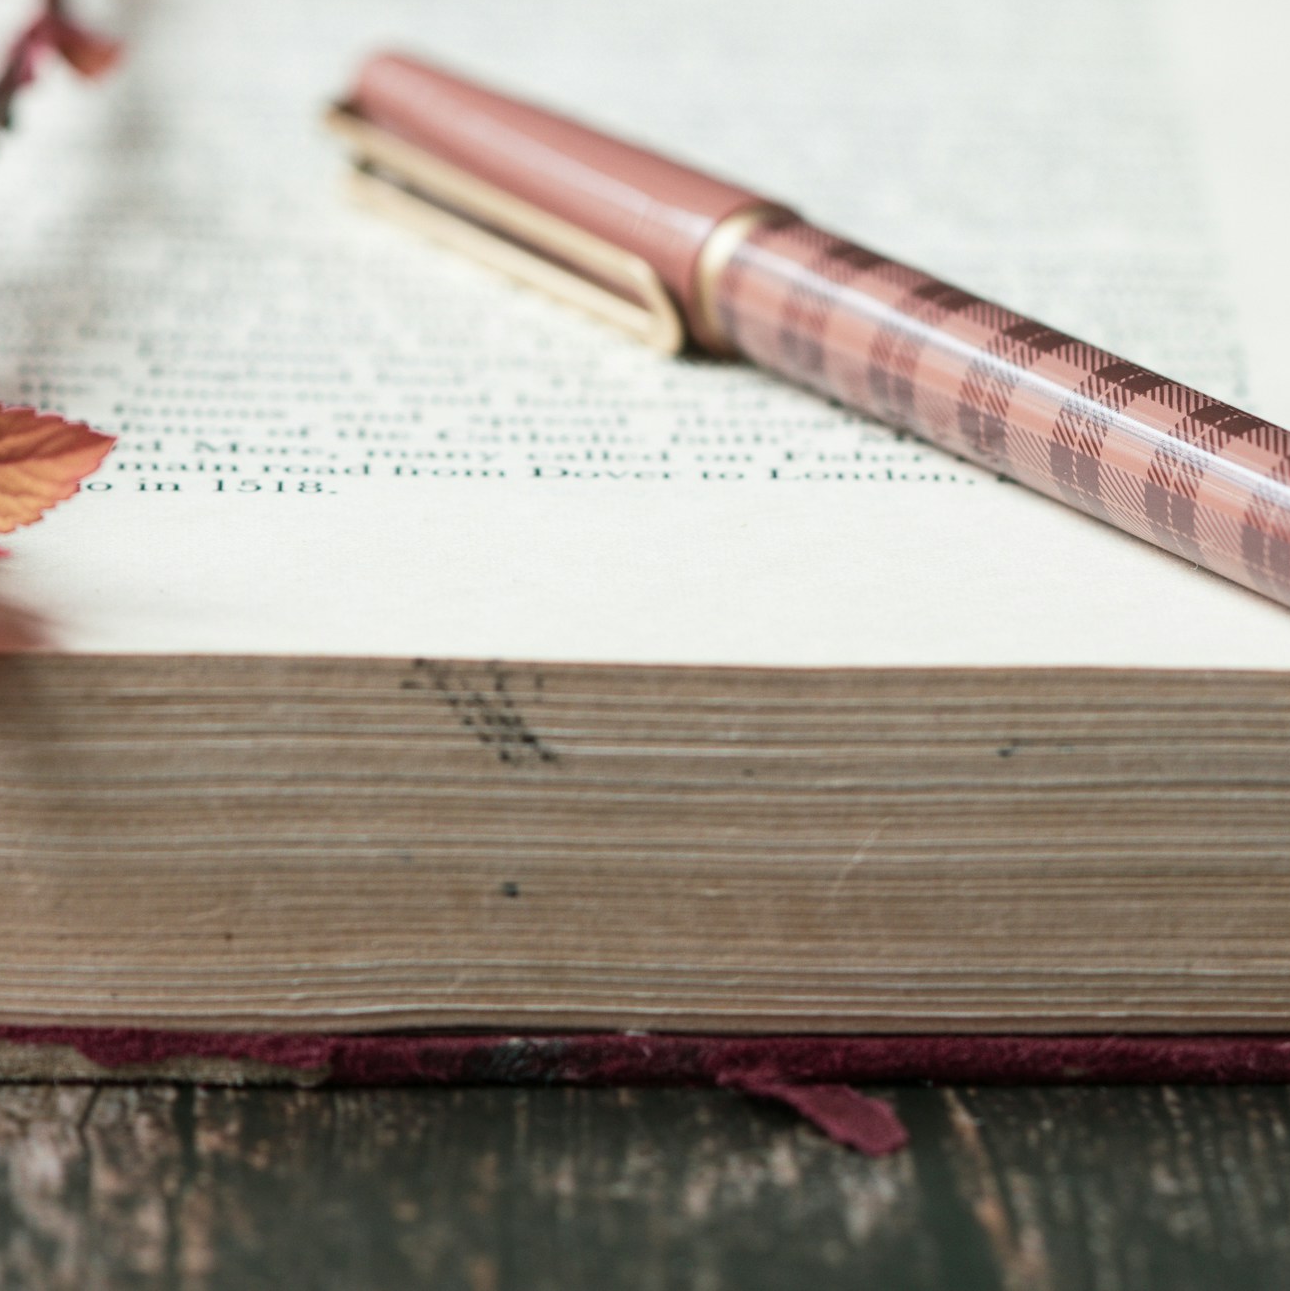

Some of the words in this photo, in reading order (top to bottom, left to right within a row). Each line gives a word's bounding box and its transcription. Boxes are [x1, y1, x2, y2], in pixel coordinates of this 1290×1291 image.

[115, 460, 239, 473] main
[261, 462, 371, 476] road
[392, 463, 506, 478] from
[532, 465, 677, 480] Dover
[700, 469, 745, 481] to
[768, 466, 979, 486] London,
[138, 478, 180, 492] in
[214, 478, 336, 494] 1518.
